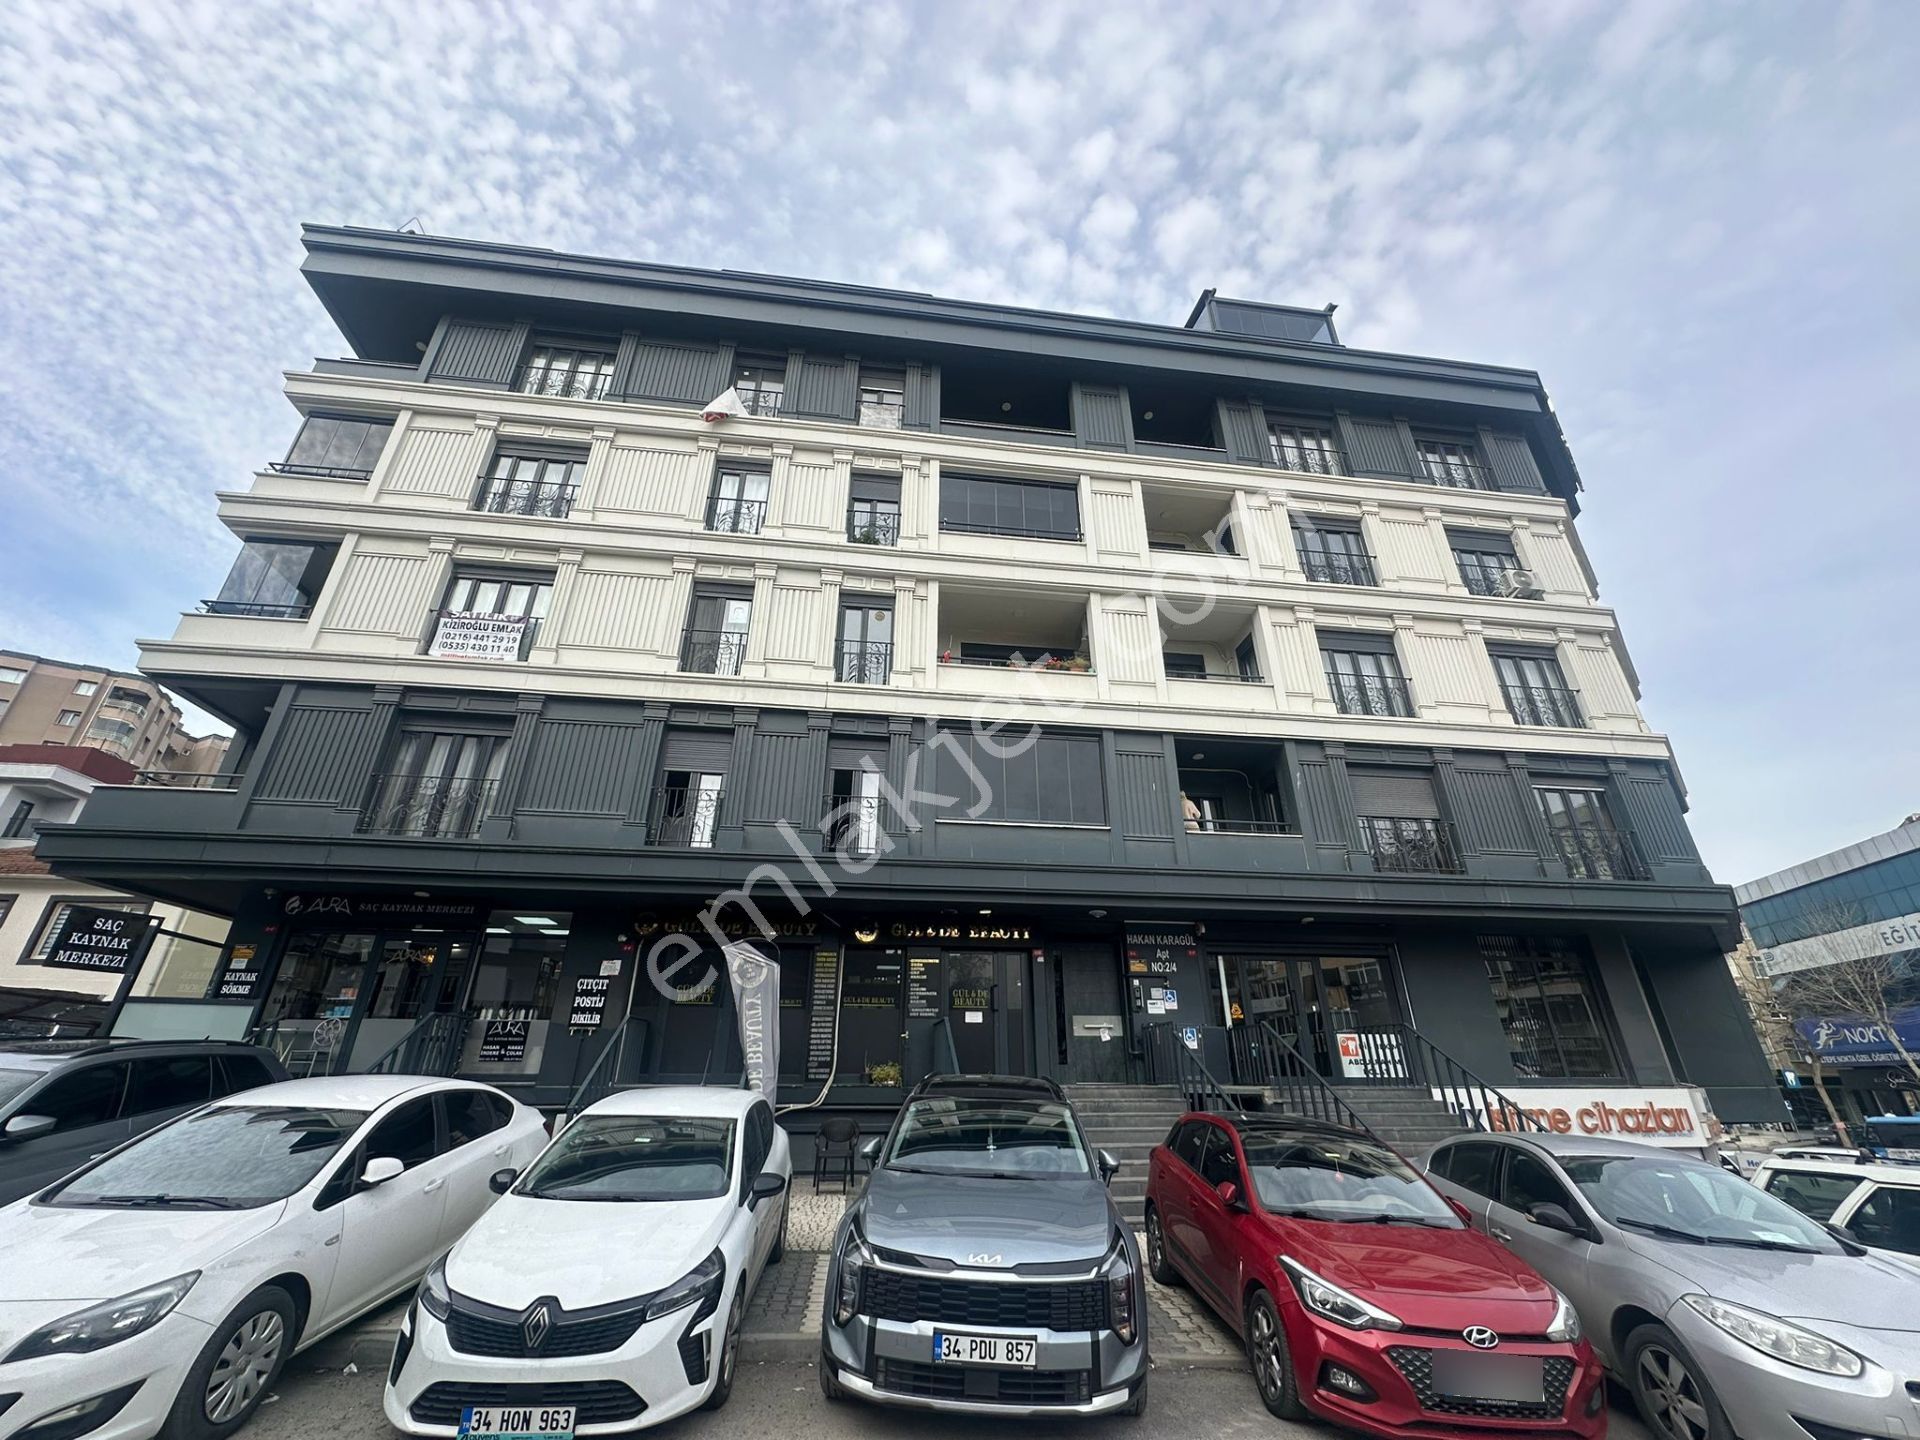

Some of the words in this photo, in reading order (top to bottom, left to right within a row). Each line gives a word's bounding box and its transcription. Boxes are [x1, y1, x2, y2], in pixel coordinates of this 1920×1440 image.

[451, 611, 508, 621] SATILIK
[442, 619, 490, 632] KİZİROĞLU
[491, 623, 522, 634] EMLAK
[441, 631, 472, 641] (0216)
[473, 634, 490, 642] 441
[493, 635, 504, 643] 29
[506, 636, 518, 644] 19
[438, 640, 469, 651] (0535)
[470, 643, 488, 652] 430
[490, 645, 501, 653] 11
[503, 645, 515, 653] 40
[381, 903, 424, 914] KAYNAK
[93, 917, 124, 934] SAÇ
[1880, 918, 1920, 947] EĞİT
[67, 932, 131, 950] KAYNAK
[1126, 934, 1155, 945] HAKAN
[1156, 934, 1197, 945] KARAGÜL
[54, 950, 128, 968] MERKEZİ
[1156, 948, 1169, 960] Apt
[223, 972, 258, 982] KAYNAK
[220, 982, 251, 995] SÖKME
[576, 978, 610, 993] ÇITÇIT
[573, 994, 605, 1008] POSTİJ
[954, 997, 987, 1006] BEAUTY
[571, 1011, 601, 1024] DİKİLİR
[1843, 1026, 1905, 1044] NOKT
[943, 1336, 961, 1358] 34
[969, 1339, 997, 1361] PDU
[1005, 1341, 1034, 1363] 857
[471, 1410, 492, 1432] 34
[499, 1410, 532, 1432] HON
[538, 1409, 571, 1432] 963
